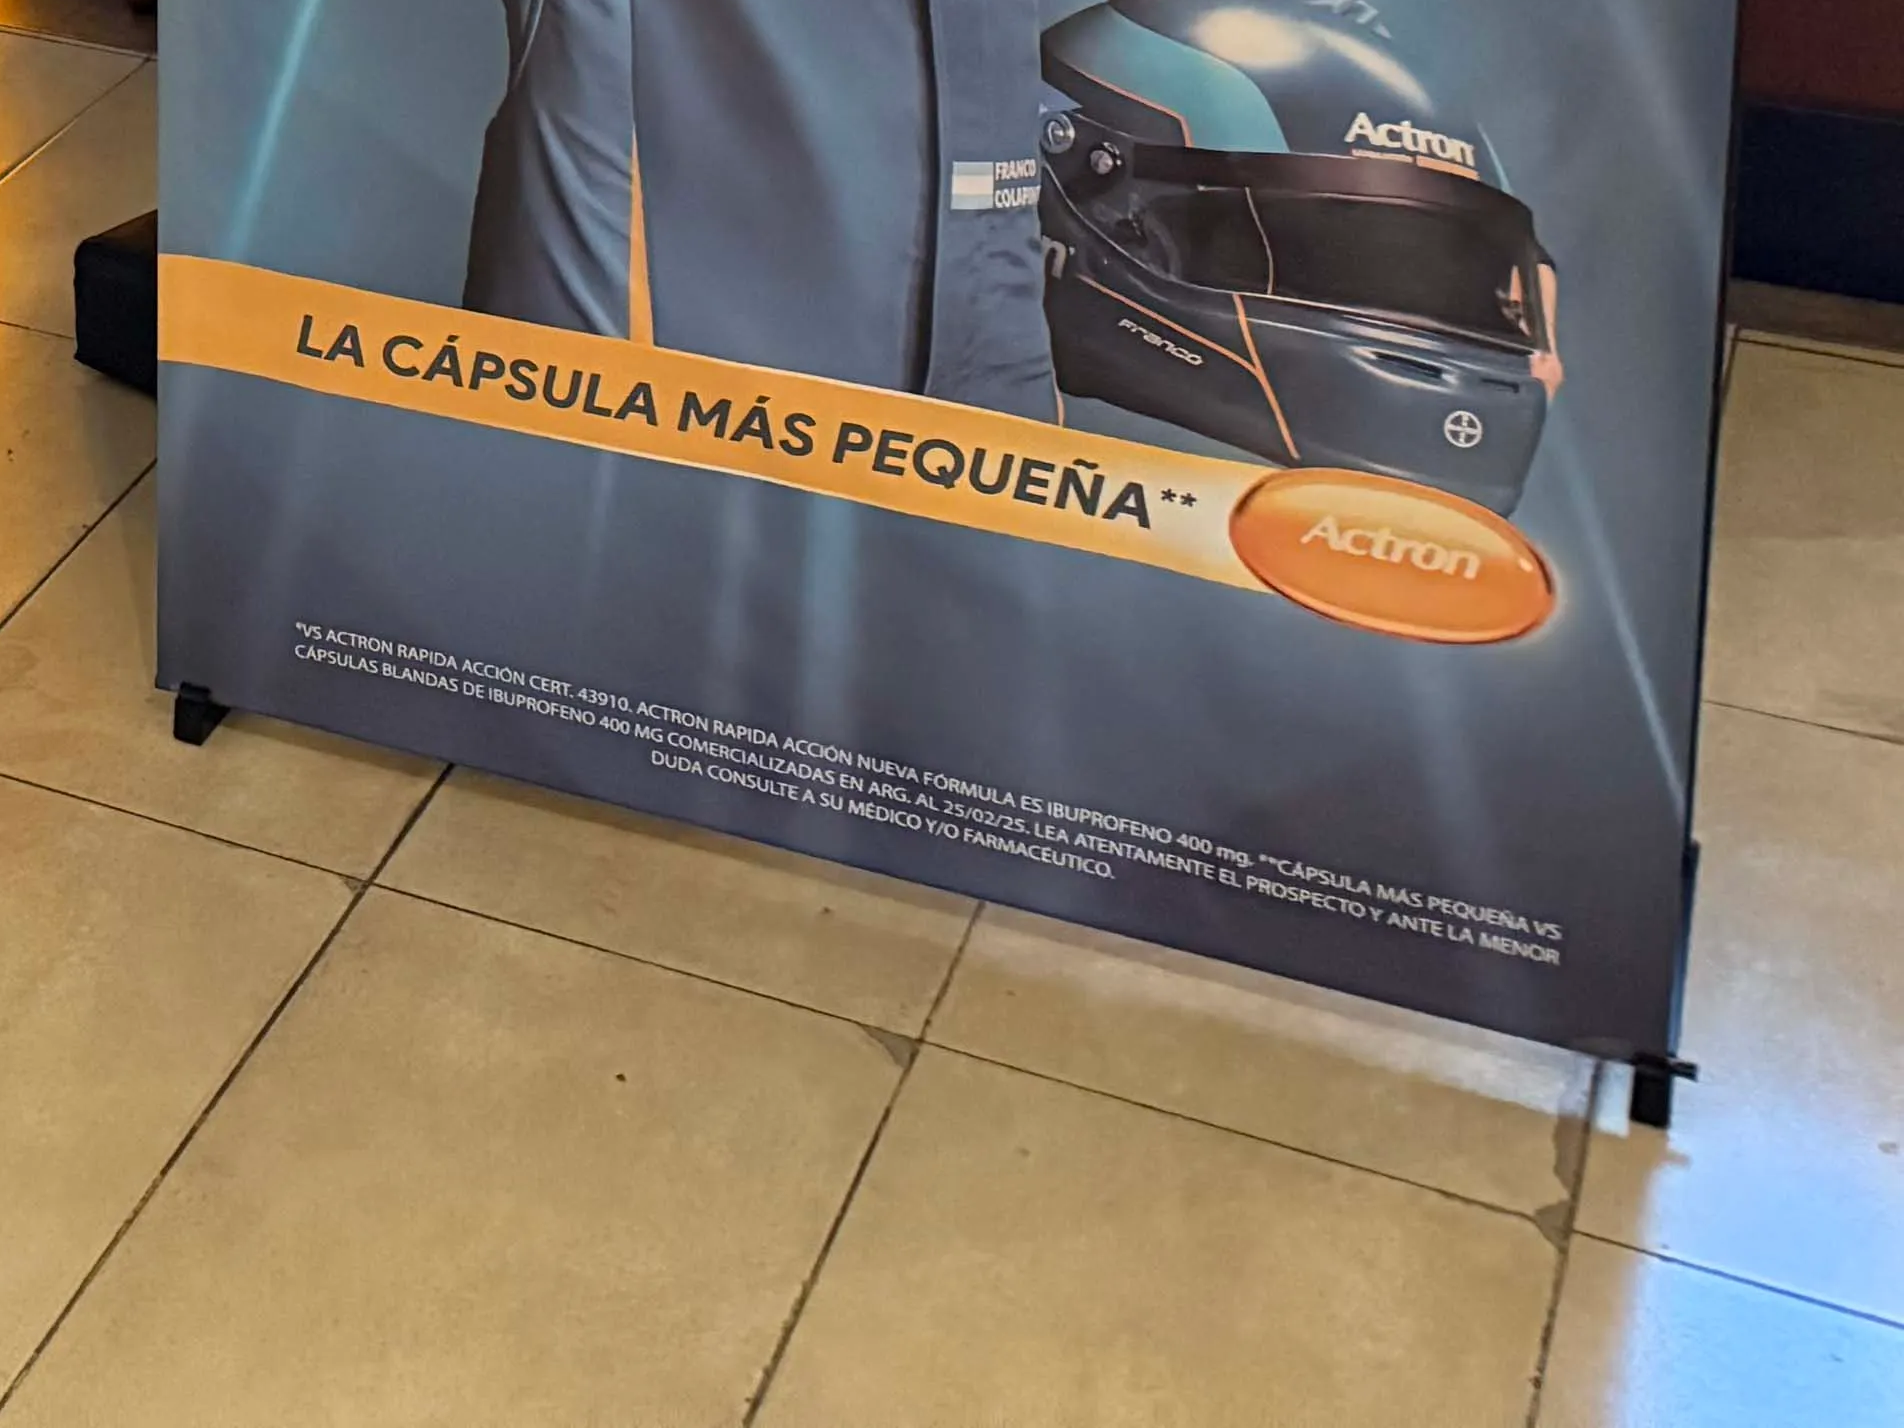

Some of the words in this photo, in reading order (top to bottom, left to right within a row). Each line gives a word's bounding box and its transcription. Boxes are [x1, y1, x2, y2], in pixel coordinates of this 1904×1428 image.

[995, 159, 1036, 180] FRANCO
[1344, 111, 1476, 167] Actron
[296, 315, 366, 367] LA
[383, 334, 658, 426] CÁPSULA
[678, 395, 817, 457] MÁS
[1300, 515, 1481, 580] Actron
[294, 643, 379, 674] CÁPSULAS
[382, 662, 459, 693] BLANDAS
[463, 680, 485, 700] DE
[488, 687, 596, 726] IBUPROFENO
[599, 715, 630, 736] 400
[635, 722, 664, 743] MG
[667, 731, 835, 786] COMERCIALIZADAS
[840, 772, 864, 793] EN
[868, 781, 912, 805] ARG.
[915, 792, 941, 812] AL
[1034, 821, 1070, 845] LEA
[1074, 833, 1215, 881] ATENTAMENTE
[1219, 867, 1243, 889] EL
[1246, 874, 1366, 920] PROSPECTO
[1369, 905, 1385, 923] Y
[1387, 911, 1443, 937] ANTE
[1447, 924, 1475, 945] LA
[1478, 931, 1561, 967] MENOR
[326, 629, 394, 656] ACTRON
[462, 659, 526, 687] ACCIÓN
[529, 675, 574, 699] CERT.
[578, 687, 634, 713] 43910.
[636, 701, 709, 732] ACTRON
[783, 736, 852, 766] ACCIÓN
[858, 753, 920, 784] NUEVA
[924, 771, 1016, 808] FÓRMULA
[1021, 795, 1043, 815] ES
[1048, 801, 1173, 845] IBUPROFENO
[1176, 832, 1213, 856] 400
[1216, 845, 1254, 869] mg.
[1427, 895, 1530, 934] PEQUEÑA
[1533, 920, 1563, 941] VS
[651, 749, 703, 777] DUDA
[707, 763, 799, 801] CONSULTE
[802, 788, 816, 805] A
[820, 791, 844, 812] SU
[848, 798, 923, 831] MÉDICO
[925, 816, 960, 841] Y/O
[963, 826, 1117, 880] FARMACÉUTICO.
